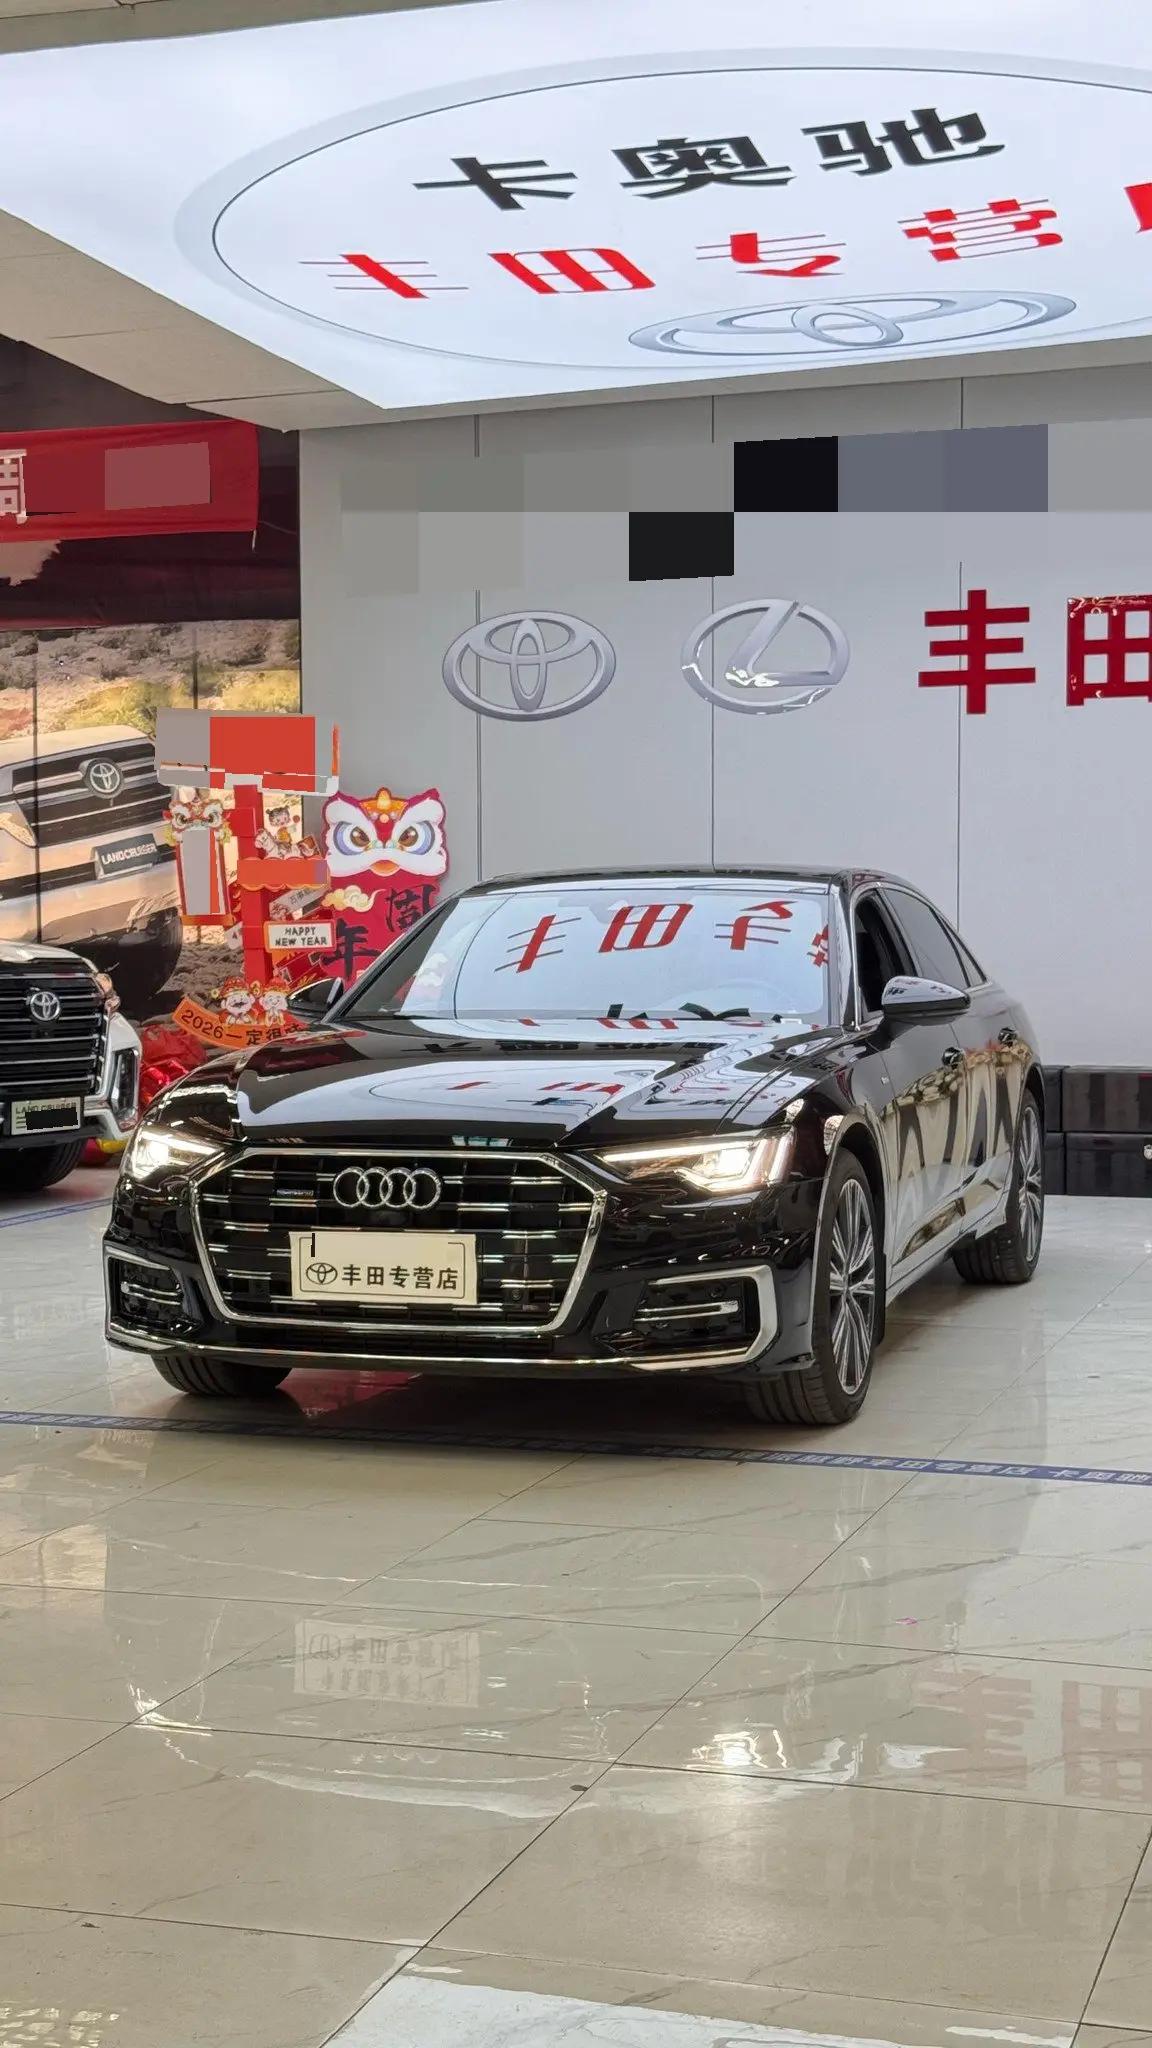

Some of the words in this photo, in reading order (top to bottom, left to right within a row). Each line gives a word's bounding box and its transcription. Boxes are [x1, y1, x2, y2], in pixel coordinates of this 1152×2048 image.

[412, 107, 1005, 211] 卡奥驰
[298, 182, 1152, 300] 丰田专营
[918, 589, 1152, 715] 丰田
[275, 937, 297, 947] NEW
[300, 936, 328, 947] YEAR
[285, 927, 316, 936] HAPPY
[341, 1264, 458, 1290] 丰田专营店
